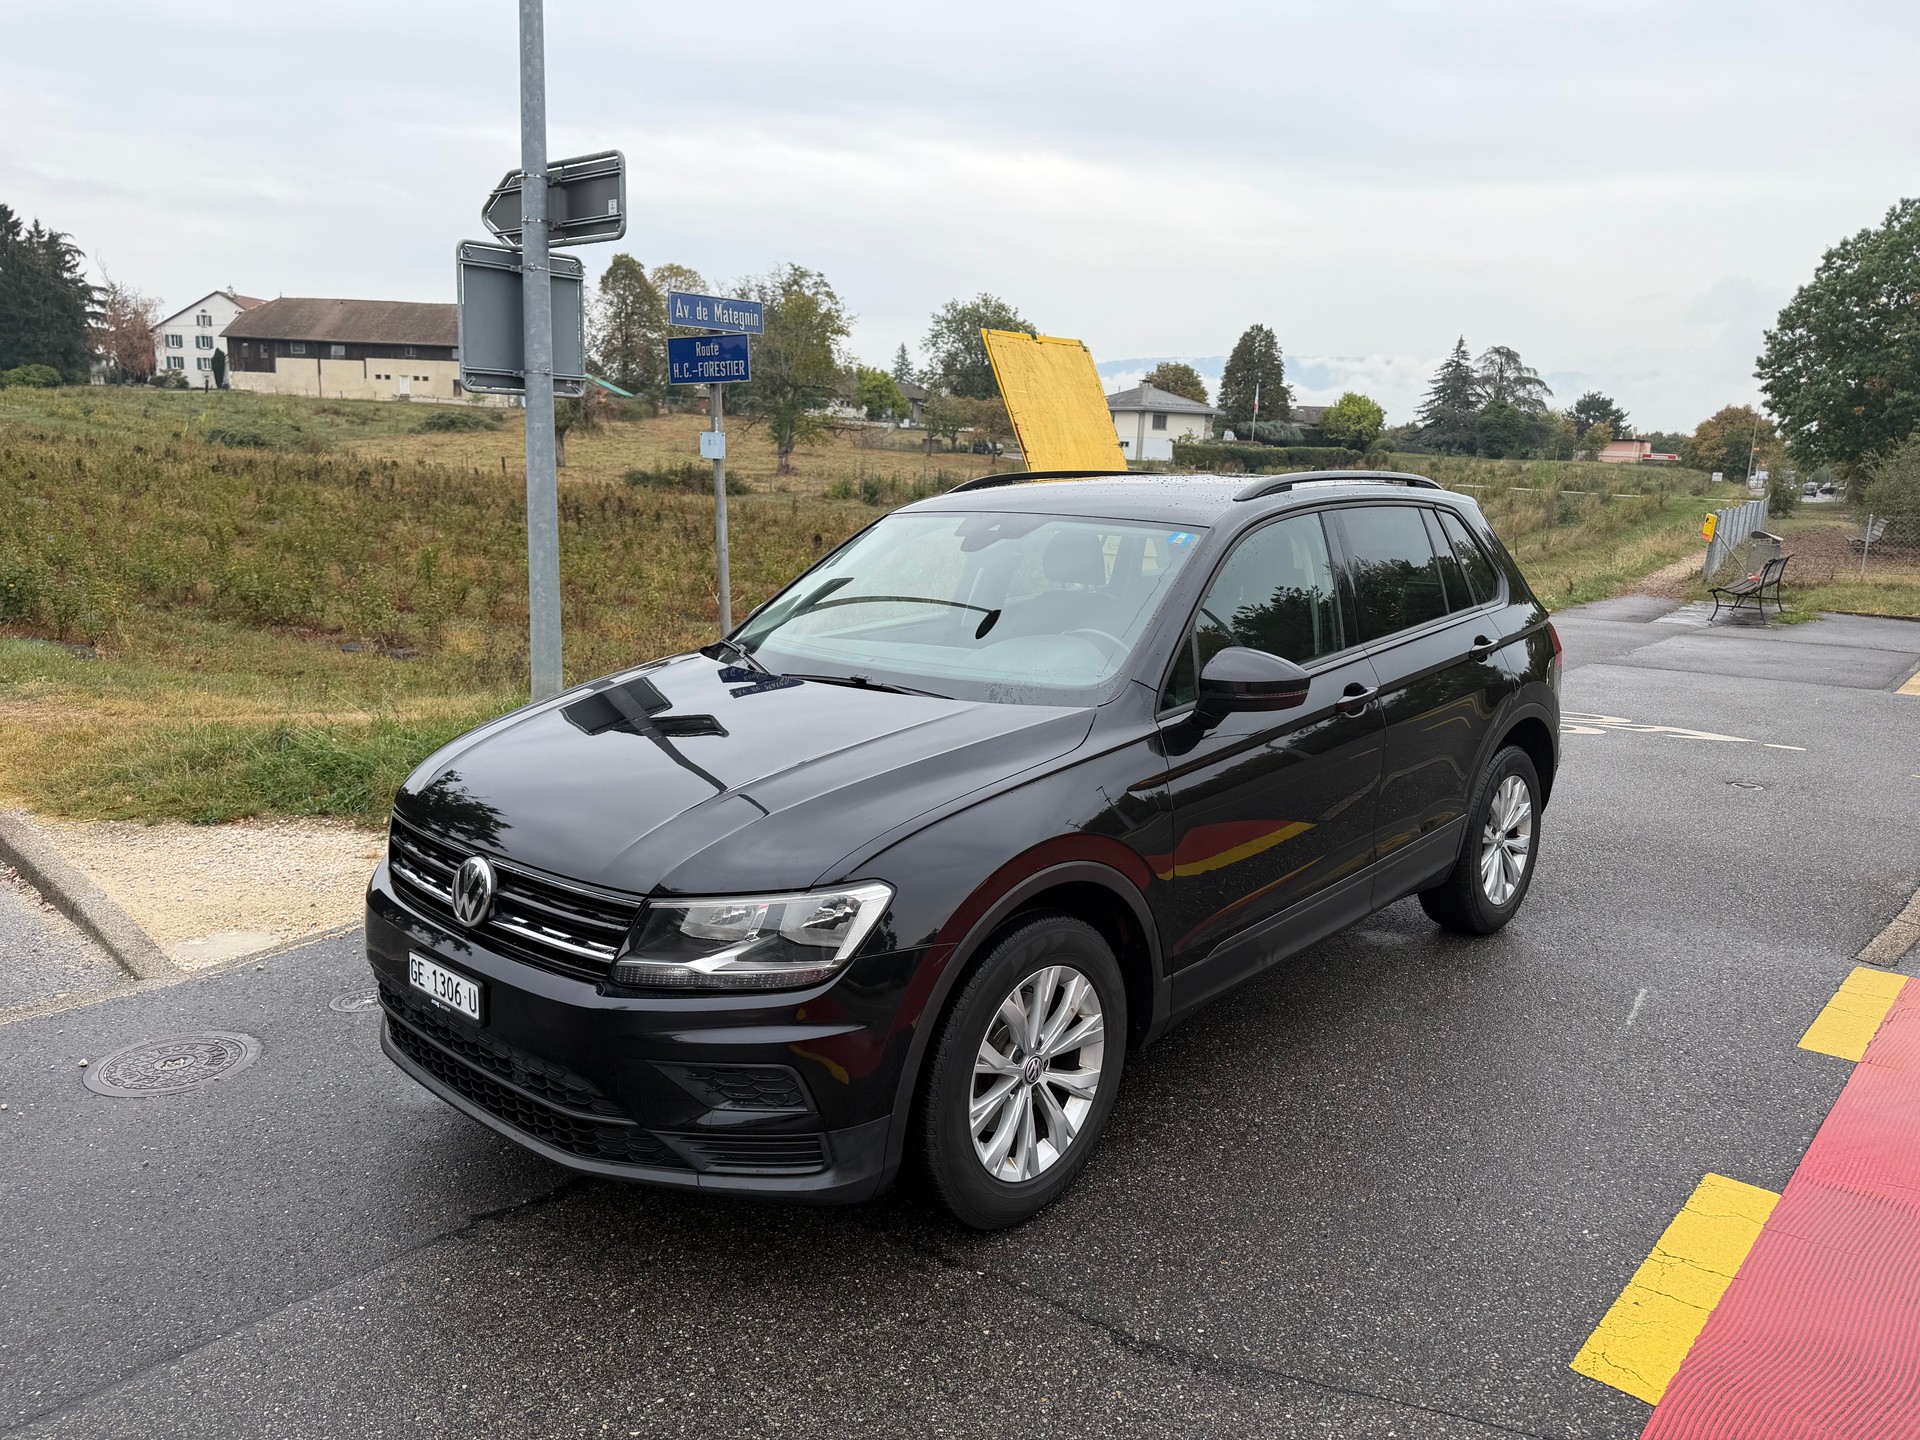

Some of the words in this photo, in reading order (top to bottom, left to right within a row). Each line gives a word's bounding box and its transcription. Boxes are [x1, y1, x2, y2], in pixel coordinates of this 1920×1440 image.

[675, 298, 693, 319] Av.
[696, 301, 708, 321] de
[714, 303, 759, 330] Mategnin
[695, 341, 720, 357] Route
